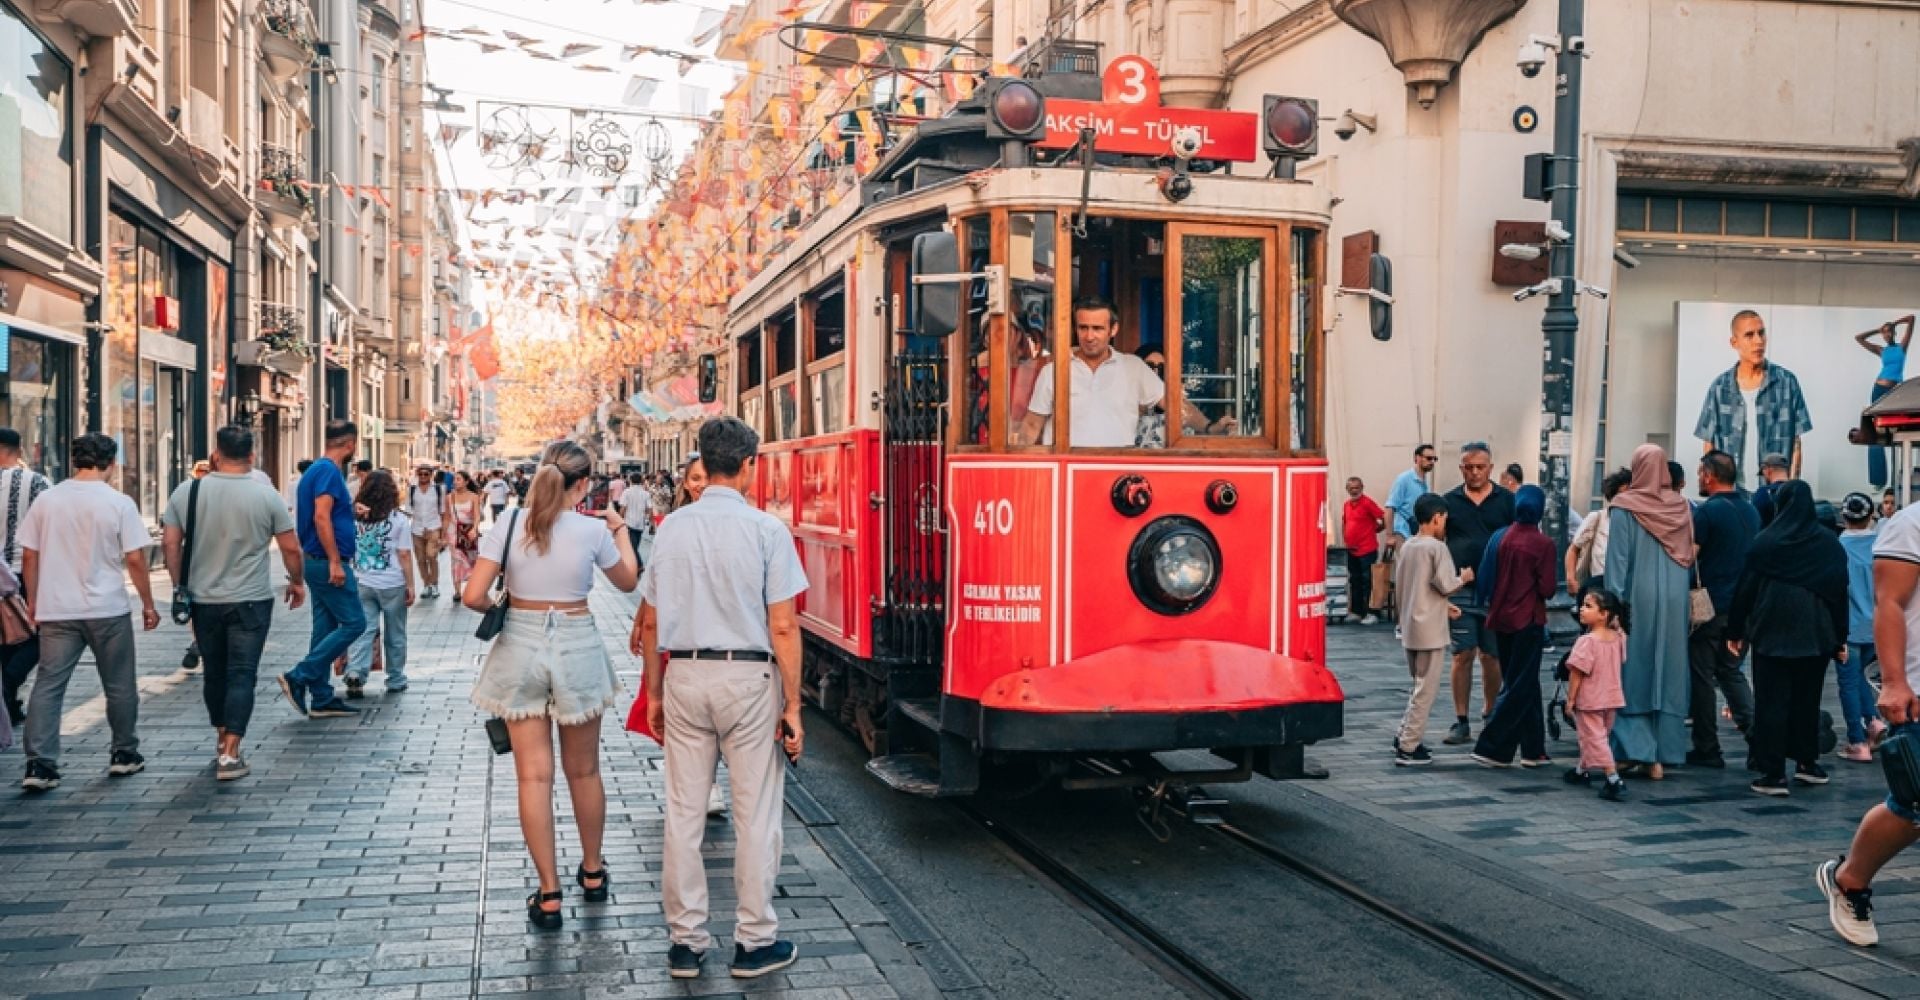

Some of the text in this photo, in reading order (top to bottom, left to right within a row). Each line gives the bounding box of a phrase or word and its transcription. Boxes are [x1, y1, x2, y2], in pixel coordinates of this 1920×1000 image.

[1118, 60, 1147, 104] 3
[1046, 111, 1114, 136] AKSİM
[1144, 118, 1215, 144] TÜL
[974, 498, 1014, 535] 410
[1004, 585, 1041, 601] YASAK
